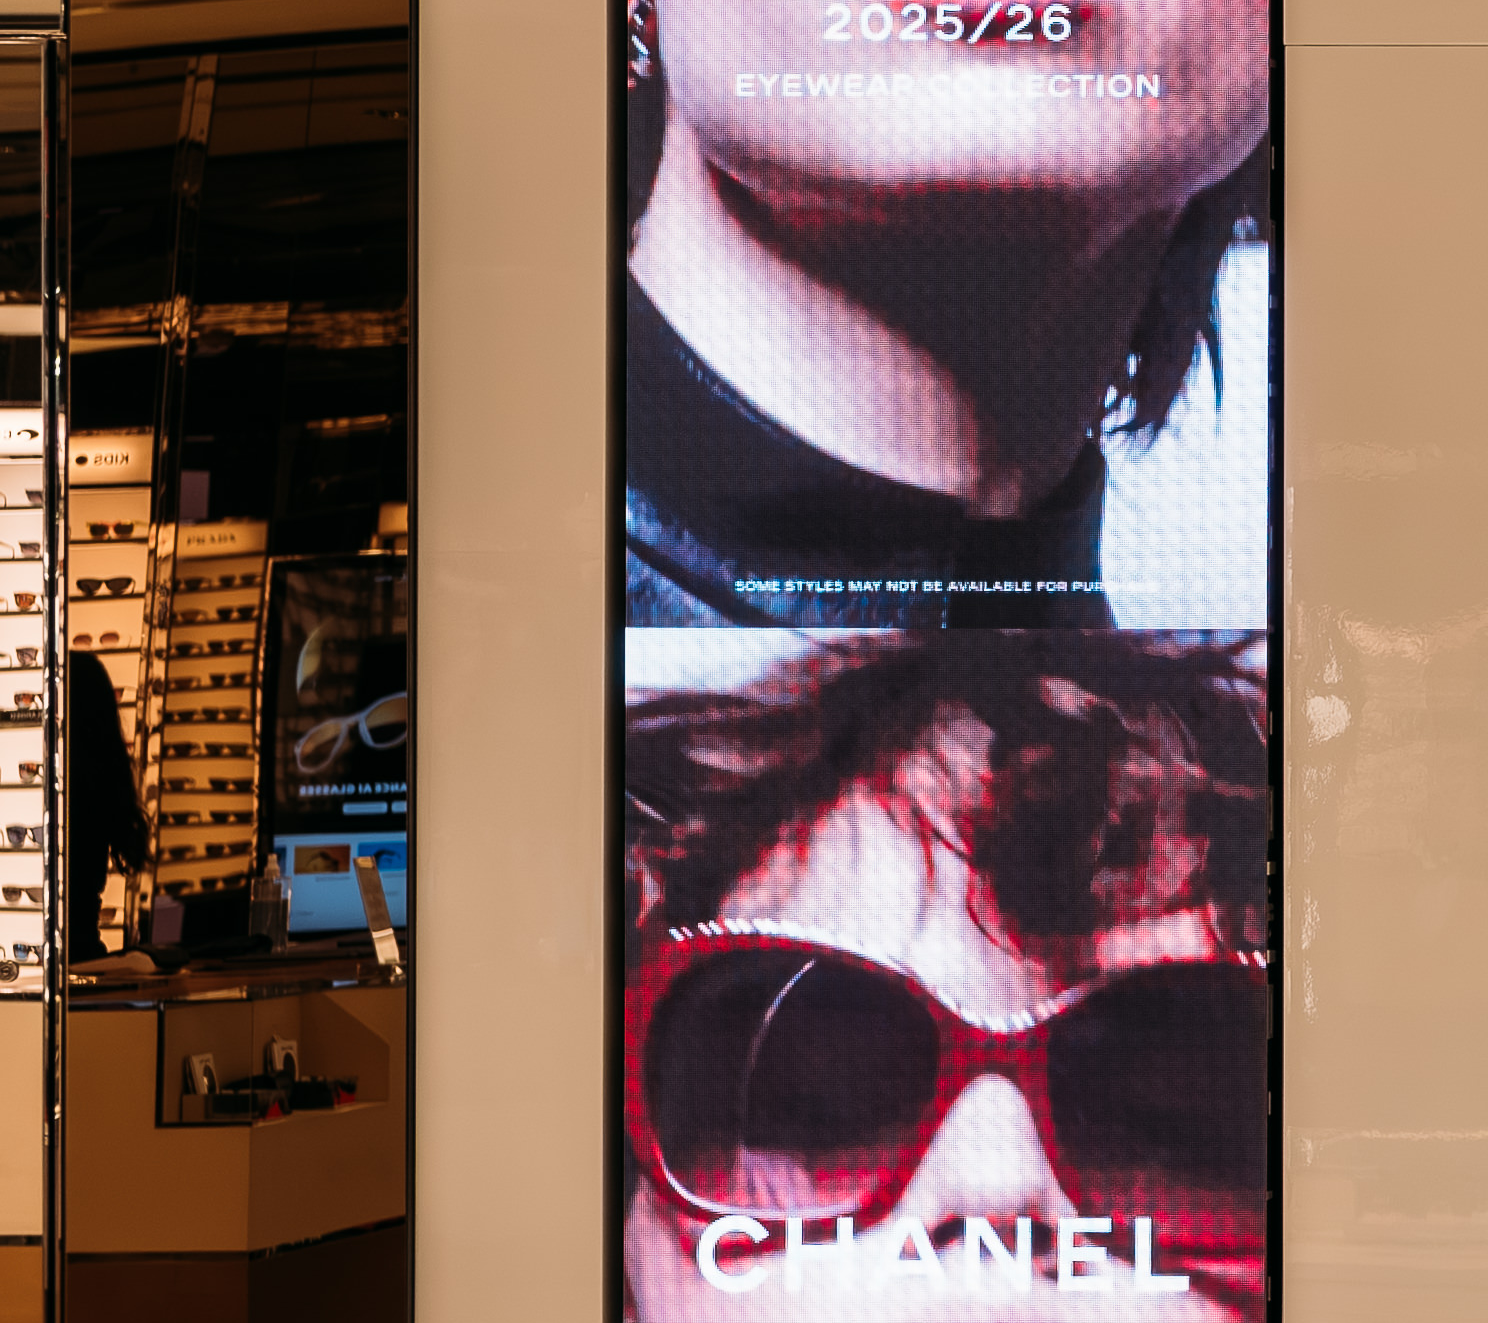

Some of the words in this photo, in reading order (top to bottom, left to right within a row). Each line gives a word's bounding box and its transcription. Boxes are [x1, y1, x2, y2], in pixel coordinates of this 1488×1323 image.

[824, 3, 1073, 43] 2025/26
[734, 73, 913, 98] EYEWEAR
[735, 579, 780, 593] SOME
[784, 579, 845, 593] STYLES
[847, 579, 882, 593] MAY
[886, 579, 919, 593] NOT
[923, 579, 944, 593] BE
[947, 579, 1031, 593] AVAILABLE
[1037, 579, 1068, 593] FOR
[696, 1215, 1191, 1294] CHANEL
